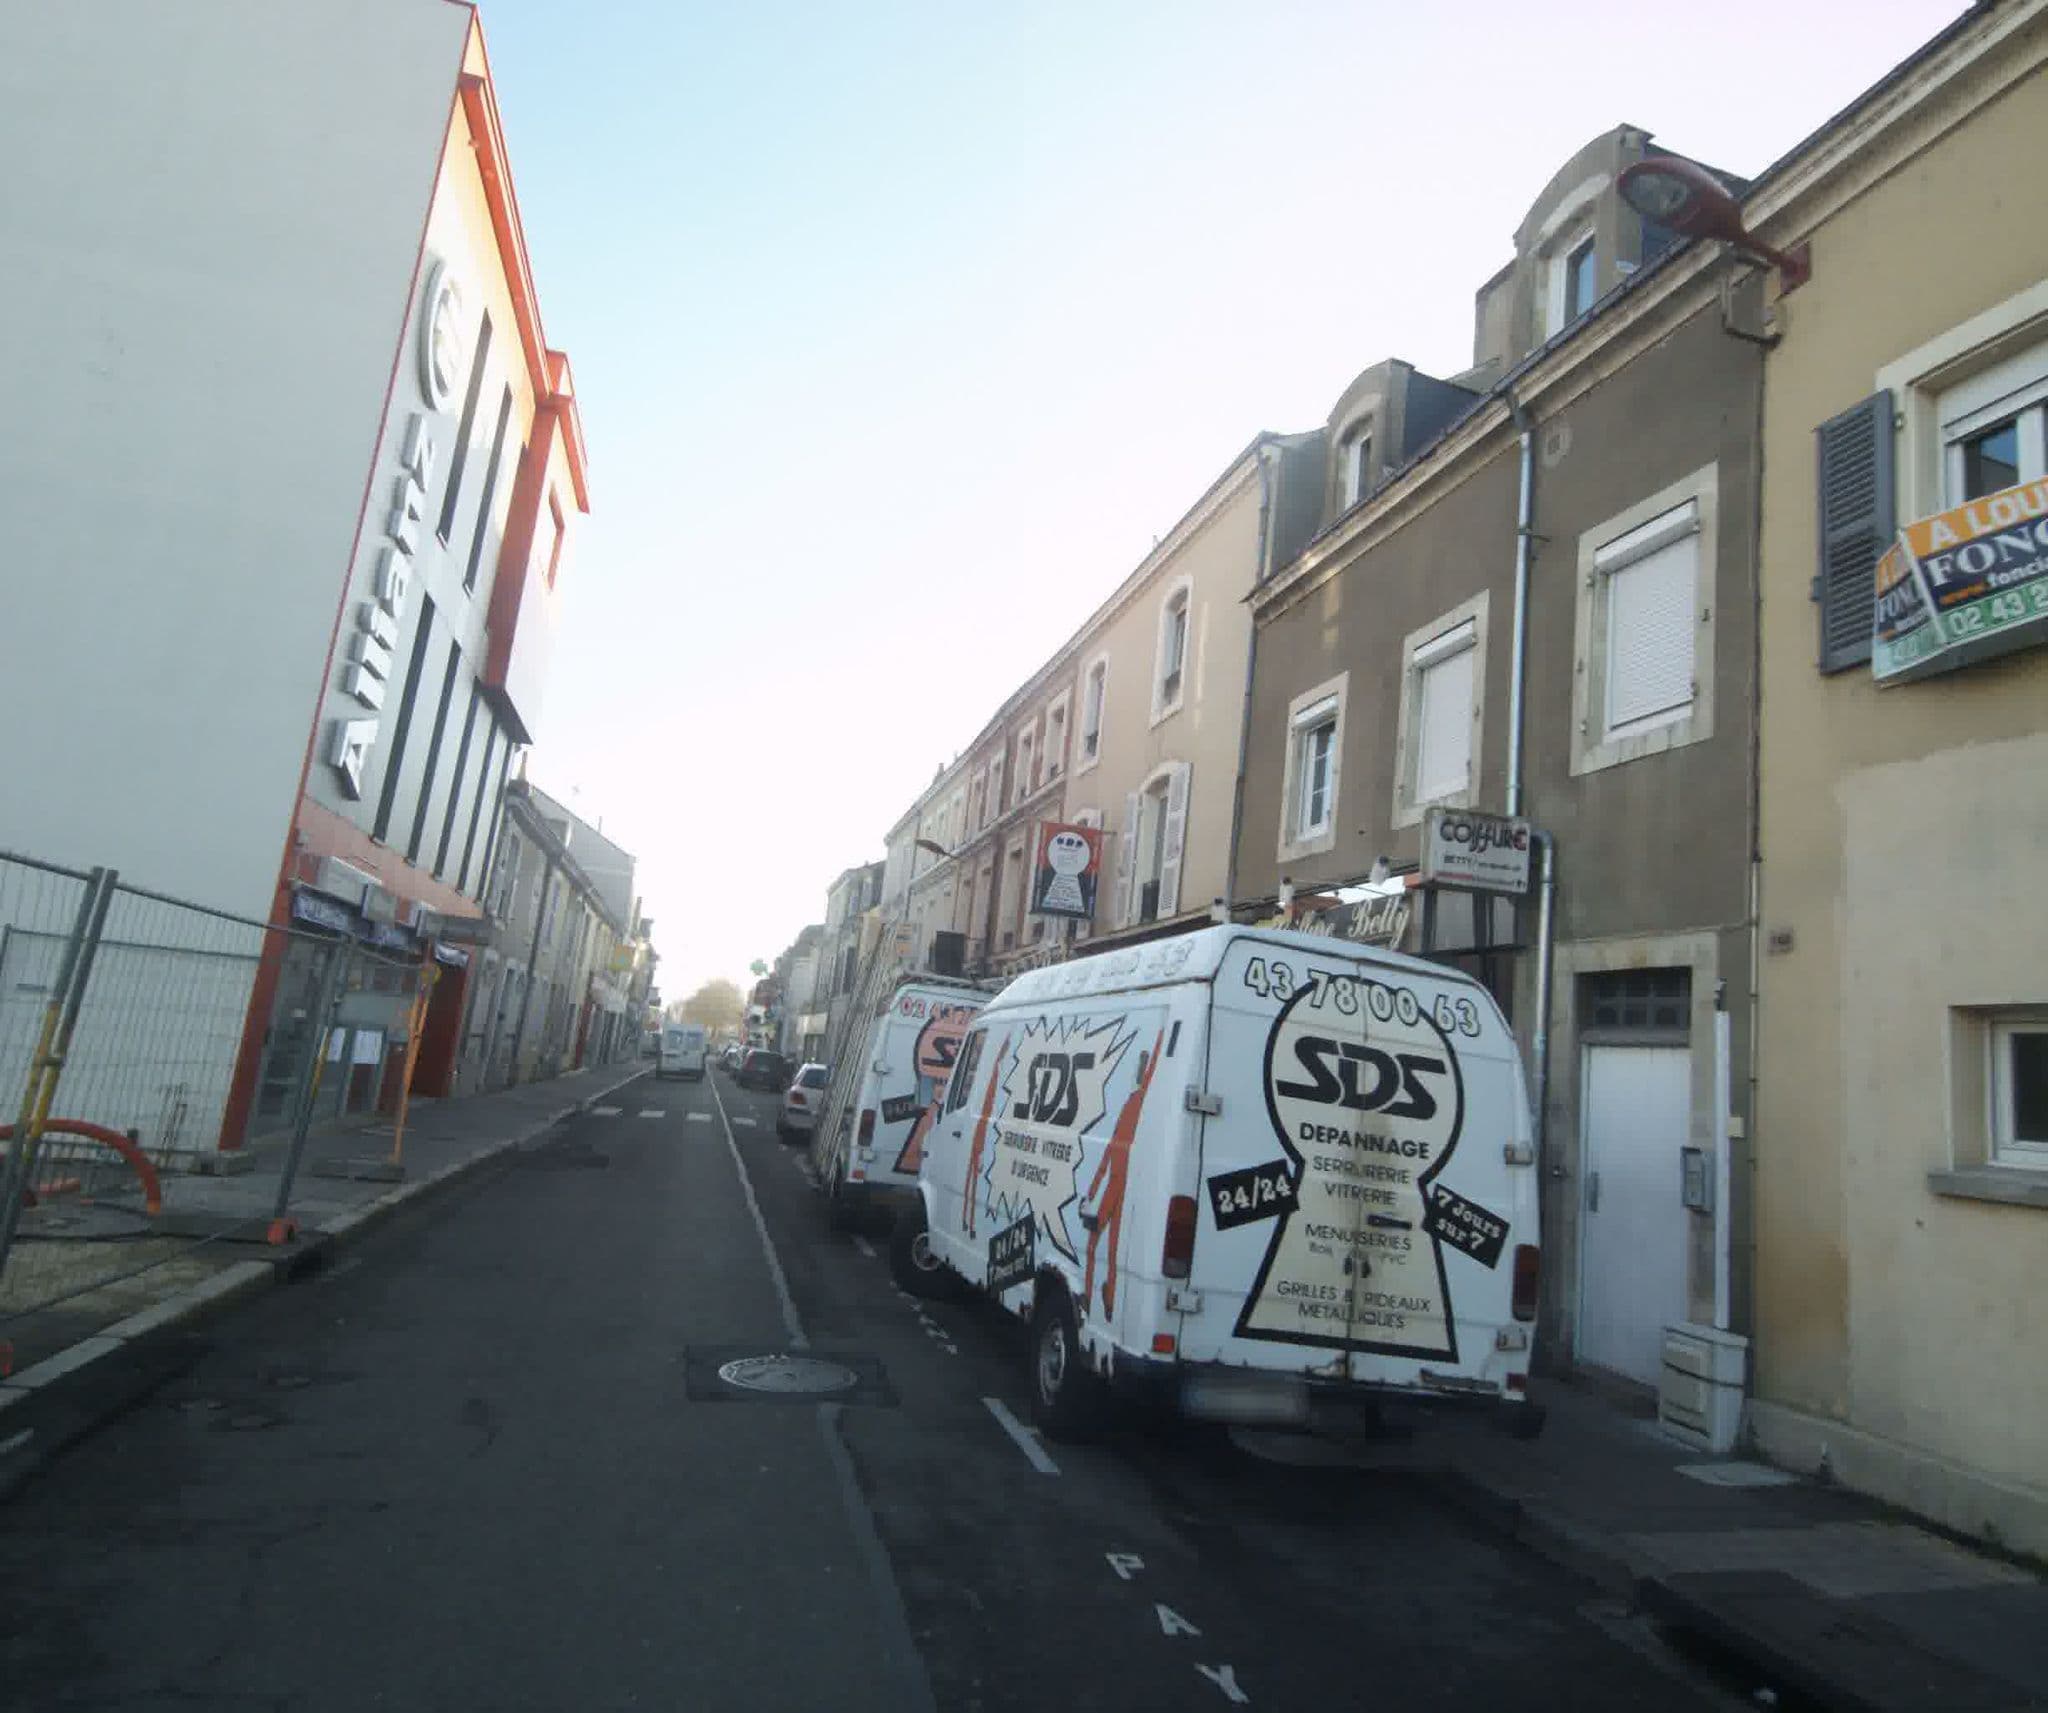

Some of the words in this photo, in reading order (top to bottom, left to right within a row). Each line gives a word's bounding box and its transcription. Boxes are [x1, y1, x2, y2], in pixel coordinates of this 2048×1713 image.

[1930, 518, 1960, 551] A
[1966, 483, 2048, 536] LOU
[330, 412, 436, 802] Allianz
[1949, 606, 1984, 634] 02
[1245, 957, 1295, 1003] 43
[1308, 968, 1360, 1016] 78
[1368, 983, 1420, 1027] 00
[1433, 993, 1482, 1038] 63
[1013, 1052, 1096, 1128] SDS
[1274, 1035, 1447, 1121] SDS
[1299, 1121, 1431, 1160] DEPANNAGE
[1217, 1173, 1293, 1214] 24/24
[1324, 1182, 1398, 1206] VITRERIE
[1437, 1188, 1454, 1208] 7
[1304, 1223, 1412, 1251] MENUSERIES
[1435, 1217, 1467, 1242] sur
[1470, 1231, 1486, 1250] 7
[1276, 1279, 1338, 1301] GRILLES
[1363, 1291, 1432, 1313] RIDEAUX
[1297, 1303, 1408, 1329] METALIQUES
